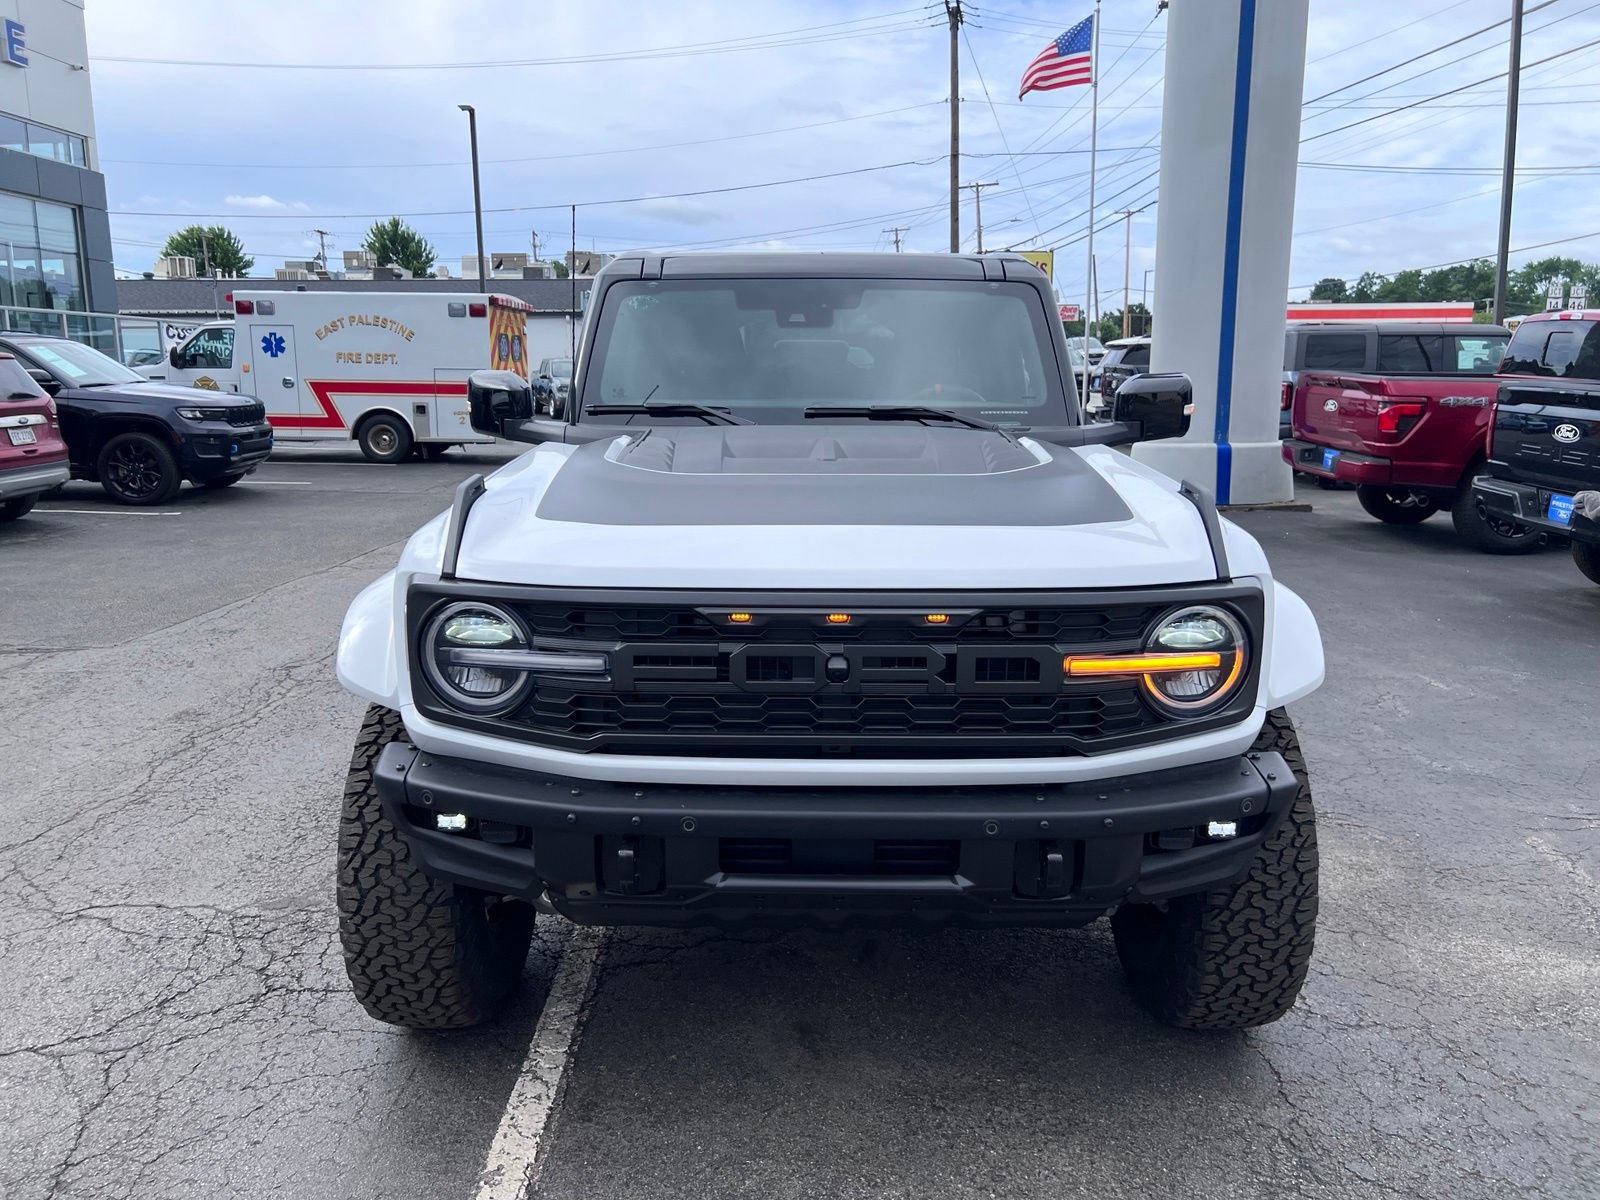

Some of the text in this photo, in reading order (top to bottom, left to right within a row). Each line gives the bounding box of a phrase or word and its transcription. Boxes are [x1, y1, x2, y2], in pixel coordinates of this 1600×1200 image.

[1569, 301, 1583, 310] 46
[315, 314, 415, 342] EAST PALESTINE
[336, 351, 398, 365] FIRE DEPT.
[458, 416, 466, 425] 2
[613, 642, 1062, 695] FORD
